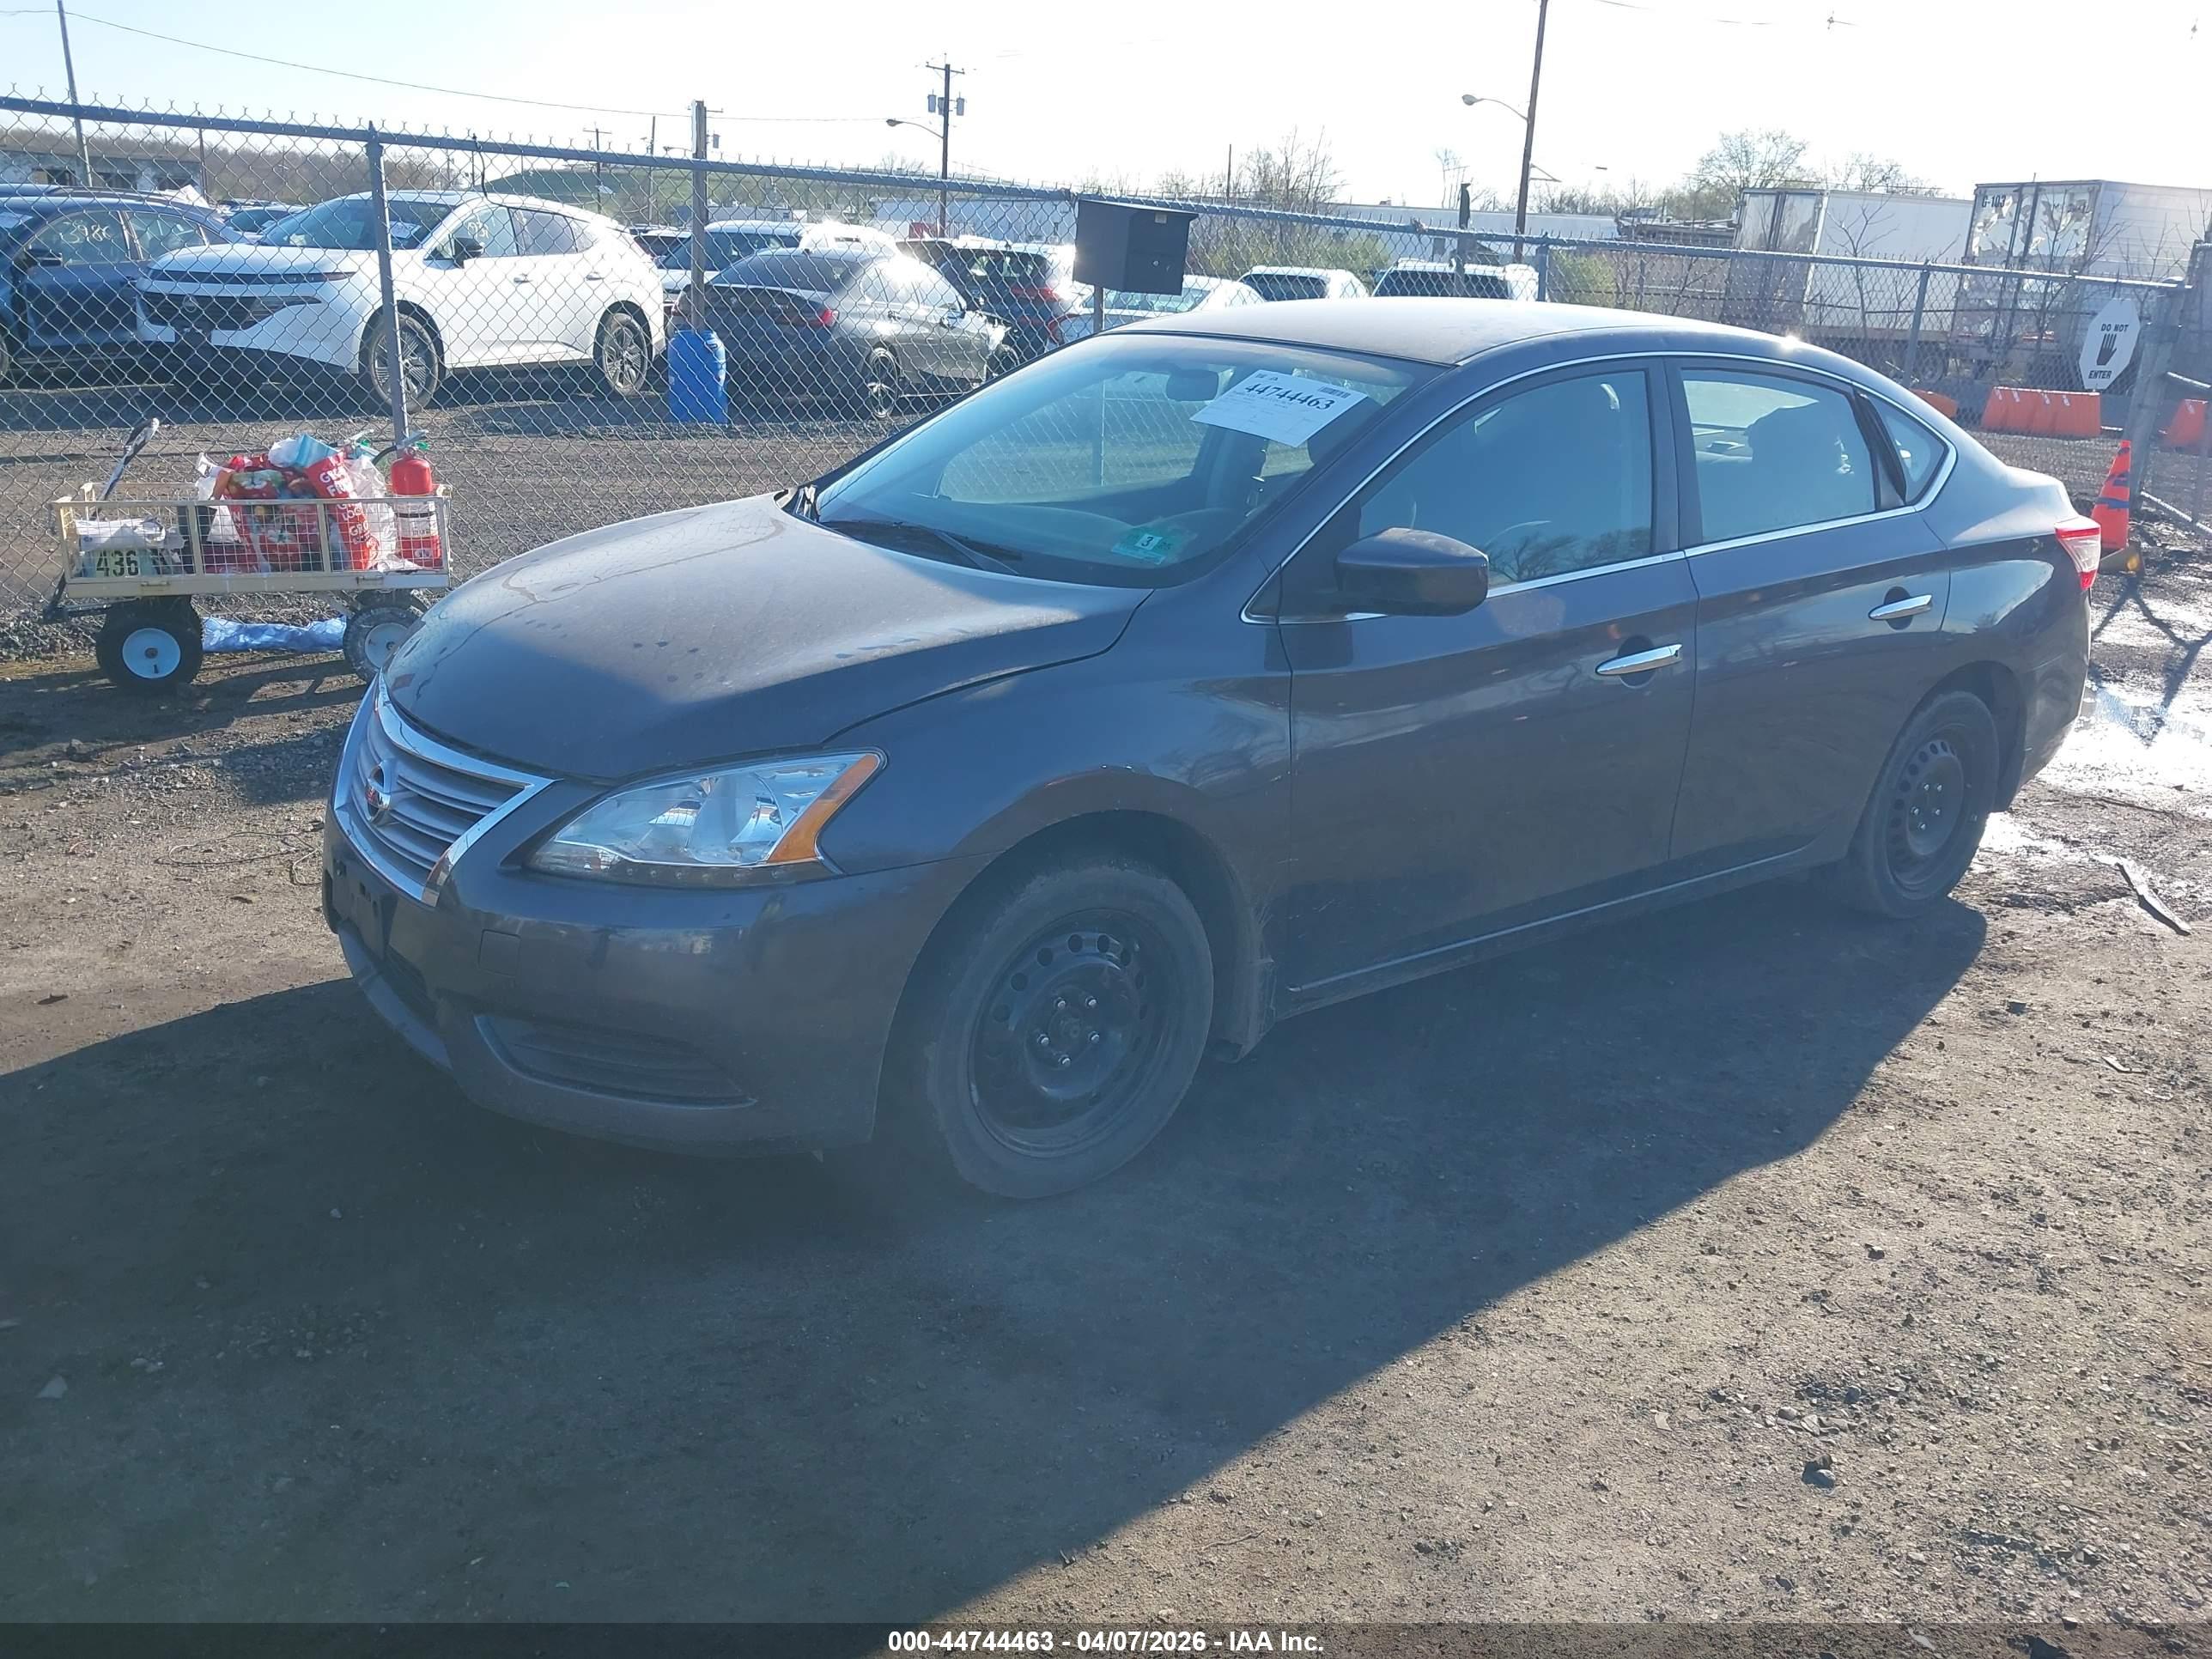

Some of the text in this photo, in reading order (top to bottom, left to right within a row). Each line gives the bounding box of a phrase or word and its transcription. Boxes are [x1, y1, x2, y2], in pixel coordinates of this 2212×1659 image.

[2100, 323, 2130, 332] DO NOT
[2087, 370, 2112, 379] ENTER
[1244, 383, 1335, 410] 44744463
[1140, 536, 1155, 547] 3
[96, 550, 139, 576] 436
